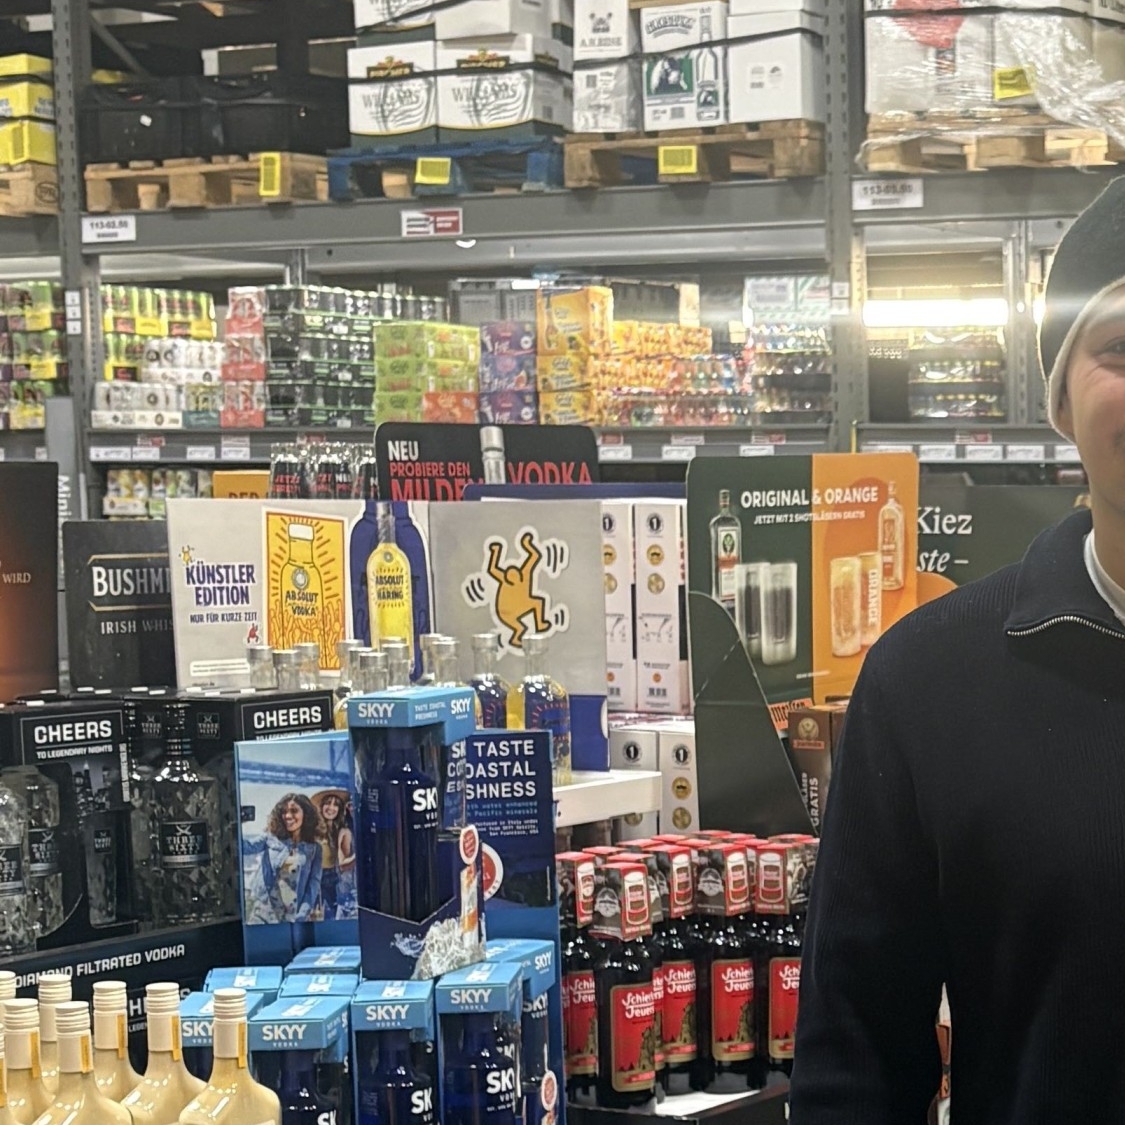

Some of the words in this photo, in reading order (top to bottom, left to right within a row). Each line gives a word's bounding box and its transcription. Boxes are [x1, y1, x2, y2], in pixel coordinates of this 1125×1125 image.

[387, 440, 419, 461] NEU
[389, 463, 445, 478] PROBIERE
[448, 462, 470, 477] DEN
[508, 461, 592, 485] VODKA
[741, 489, 809, 509] ORIGINAL
[812, 490, 822, 504] &
[824, 486, 879, 504] ORANGE
[917, 506, 973, 535] Kiez
[2, 572, 31, 585] WIRD
[186, 561, 256, 585] KÜNSTLER
[375, 574, 404, 585] ABSOLUT
[195, 585, 250, 606] EDITION
[285, 590, 319, 603] ABSOLUT
[100, 620, 137, 635] IRISH
[358, 703, 395, 718] SKYY
[450, 698, 472, 715] SKYY
[253, 706, 322, 729] CHEERS
[34, 720, 113, 745] CHEERS
[36, 751, 46, 759] TO
[47, 748, 87, 759] LEGENDARY
[473, 740, 535, 758] TASTE
[76, 952, 142, 976] FILTRATED
[145, 944, 185, 964] VODKA
[450, 989, 492, 1005] SKYY
[366, 1005, 410, 1021] SKYY
[262, 1024, 307, 1041] SKYY
